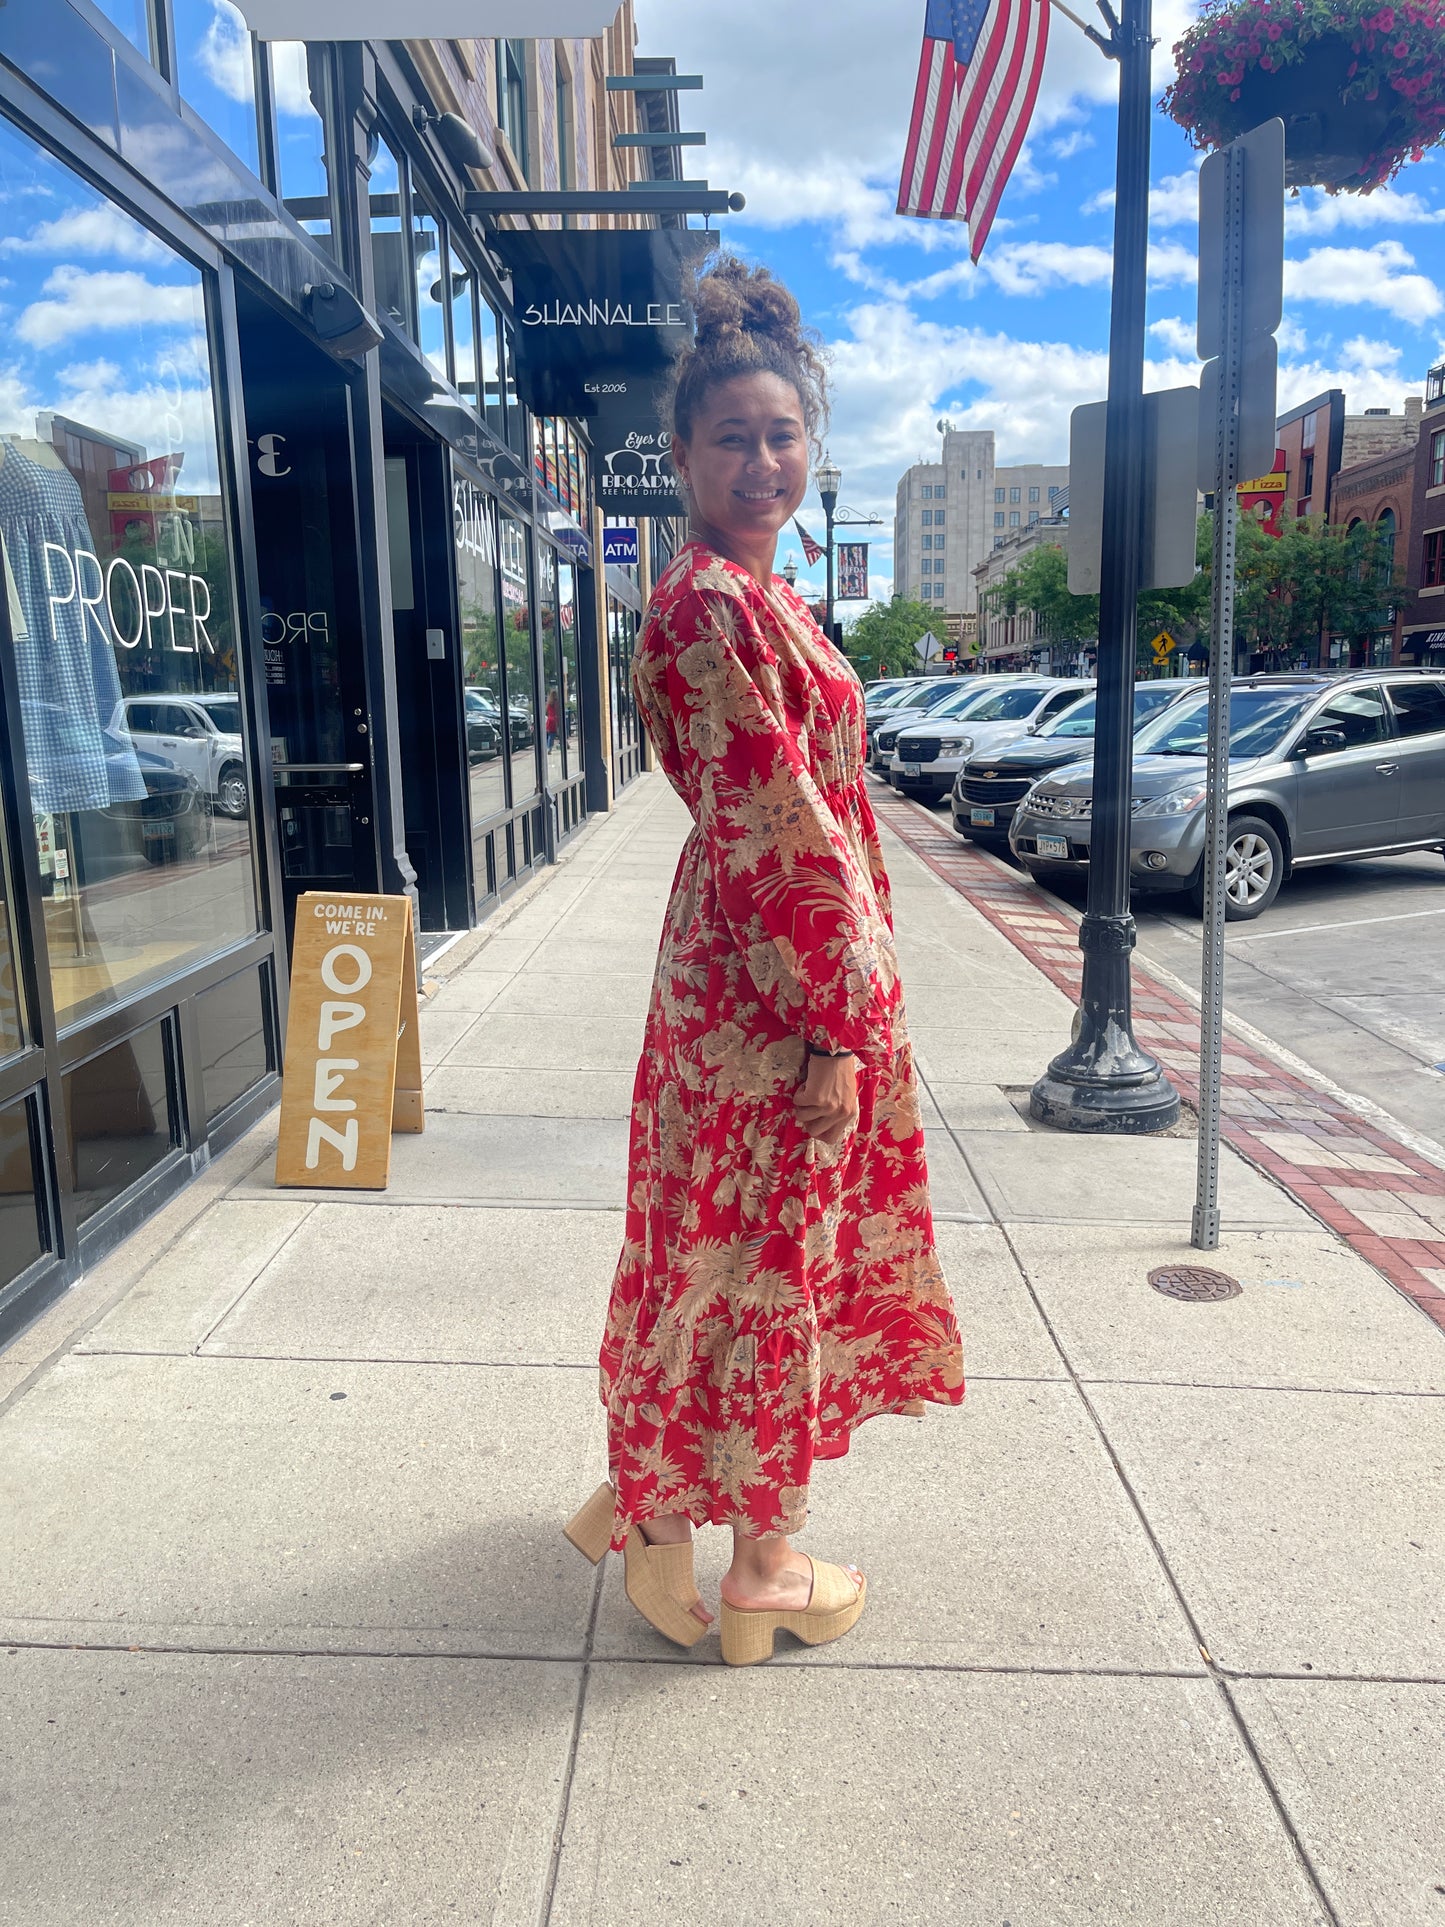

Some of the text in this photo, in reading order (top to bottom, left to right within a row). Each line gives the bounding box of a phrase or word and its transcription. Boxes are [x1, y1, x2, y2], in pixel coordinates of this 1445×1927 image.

[521, 298, 687, 325] SHANNALEE
[584, 382, 627, 393] Est 2006
[625, 431, 672, 449] Eyes O
[602, 474, 680, 488] BROADW
[1252, 478, 1283, 490] Pizza
[602, 488, 618, 496] SEE
[622, 488, 638, 496] THE
[605, 543, 637, 556] ATM
[43, 542, 216, 654] PROPER
[314, 903, 363, 919] COME
[325, 920, 377, 936] WE'RE
[305, 943, 372, 1172] OPEN
